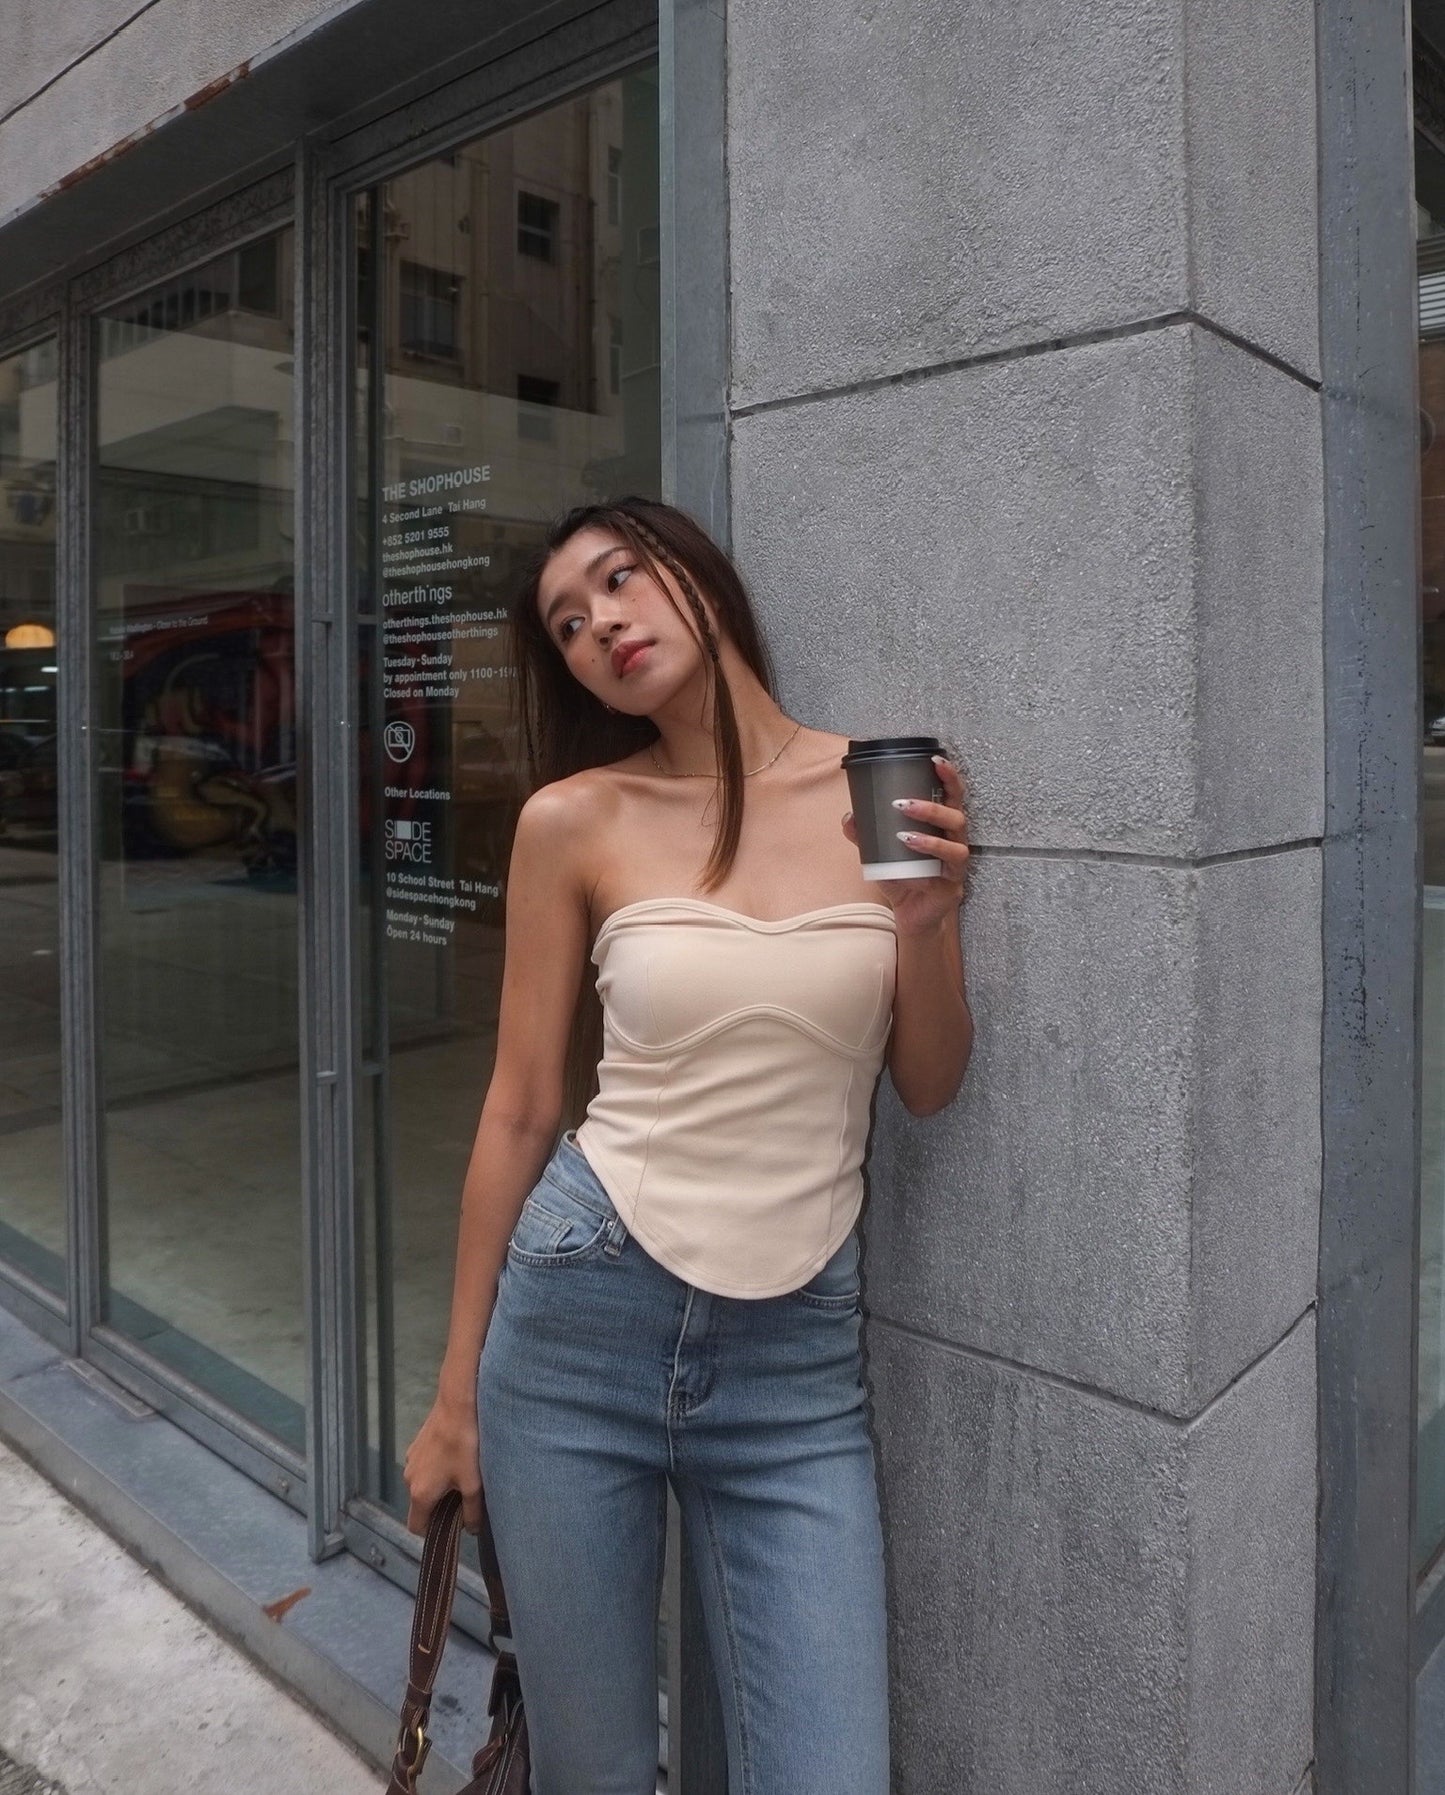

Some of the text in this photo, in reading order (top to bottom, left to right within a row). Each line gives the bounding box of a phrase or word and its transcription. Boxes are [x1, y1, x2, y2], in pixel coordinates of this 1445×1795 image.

[382, 465, 491, 501] THE SHOPHOUSE
[382, 498, 486, 524] 4 Second Lane Tai Hang
[383, 526, 450, 546] +852 5201 9555
[383, 543, 453, 562] theshophouse.hk
[383, 556, 490, 577] @theshophousehongkong
[383, 608, 508, 628] otherthings.theshophouse.hk
[383, 627, 498, 644] @theshophouseotherthings
[384, 674, 394, 684] by
[395, 671, 447, 683] appointment
[449, 669, 467, 681] only
[383, 686, 460, 699] Closed on Monday
[385, 786, 451, 800] Other Locations
[385, 840, 431, 863] SPACE
[386, 872, 499, 897] 10 School Street Tai Hang
[386, 887, 476, 911] @sidespacehongkong
[386, 925, 447, 945] Open 24 hours
